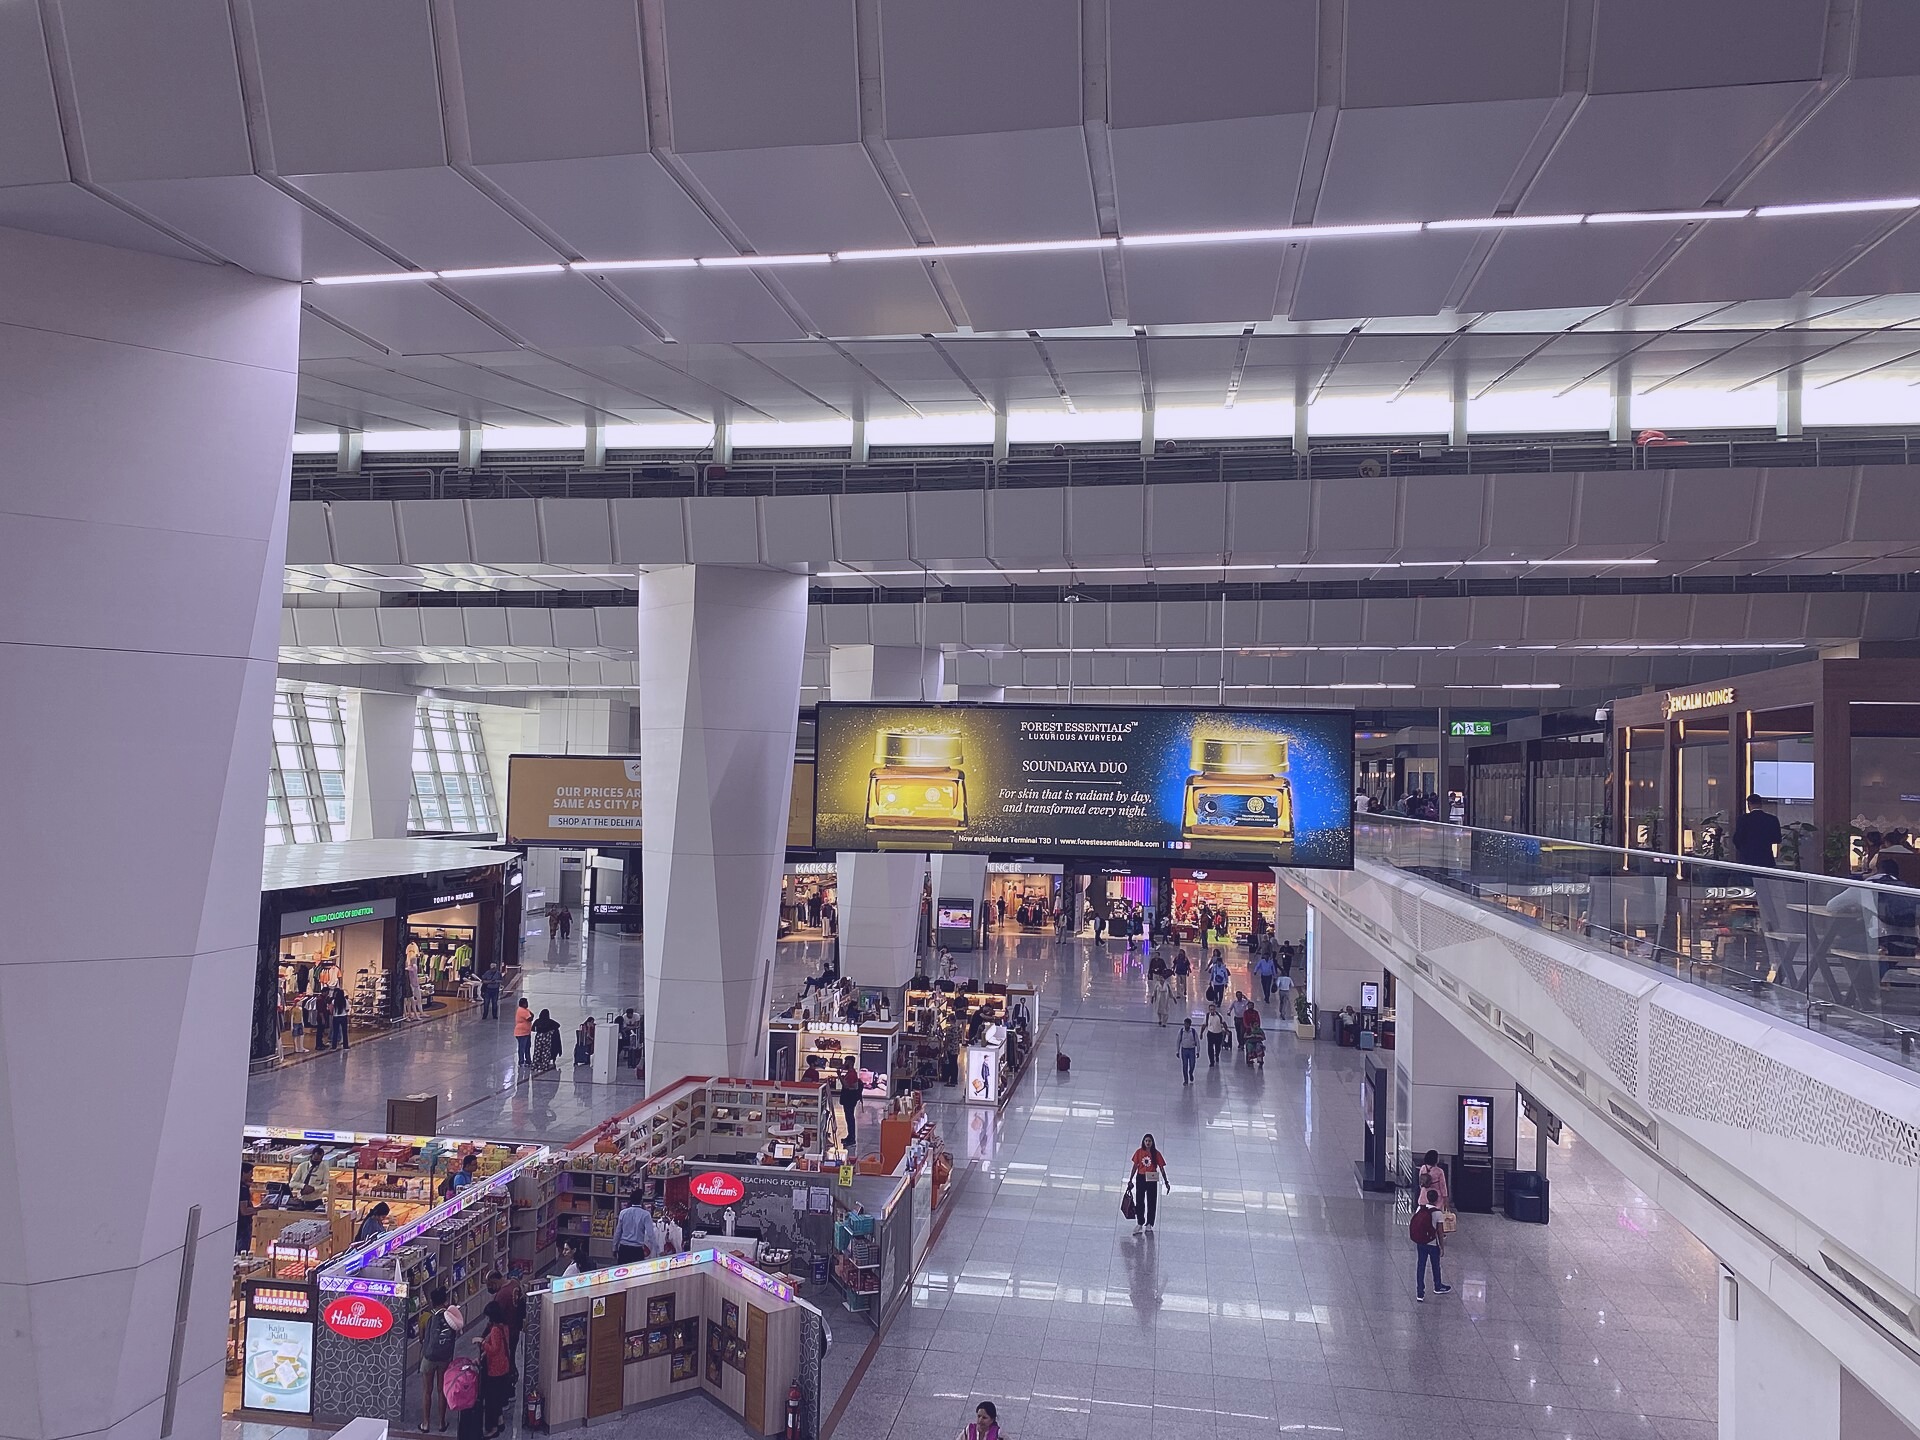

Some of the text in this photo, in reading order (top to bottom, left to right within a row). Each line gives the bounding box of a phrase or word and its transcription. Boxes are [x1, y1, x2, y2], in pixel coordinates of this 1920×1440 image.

[1671, 687, 1735, 712] ENCALM LOUNGE
[1021, 722, 1063, 732] FOREST
[1029, 733, 1123, 742] LUXURIOUS AYURVEDA
[1022, 760, 1128, 774] SOUNDARYA DUO
[556, 786, 581, 797] OUR
[583, 787, 624, 798] PRICES
[998, 788, 1152, 804] For skin that is radiant by day,
[553, 798, 585, 809] SAME
[587, 799, 602, 809] AS
[603, 799, 629, 810] CITY
[1002, 802, 1148, 818] and transformed every night.
[558, 817, 580, 827] SHOP
[581, 818, 592, 827] AT
[593, 818, 608, 827] THE
[610, 818, 634, 827] DELHI
[1010, 836, 1038, 844] Terminal
[1059, 838, 1160, 848] www.forestessentialsindia.com
[795, 863, 835, 874] MARKS &
[310, 914, 328, 924] UNITED
[328, 911, 345, 921] COLORS
[345, 910, 352, 918] OF
[807, 1021, 858, 1032] HIDESIGN
[740, 1176, 807, 1187] REACHING PEOPLE
[696, 1183, 738, 1197] Haldiram's
[253, 1295, 308, 1308] BIKANERVALA
[331, 1309, 383, 1328] Haldiram's
